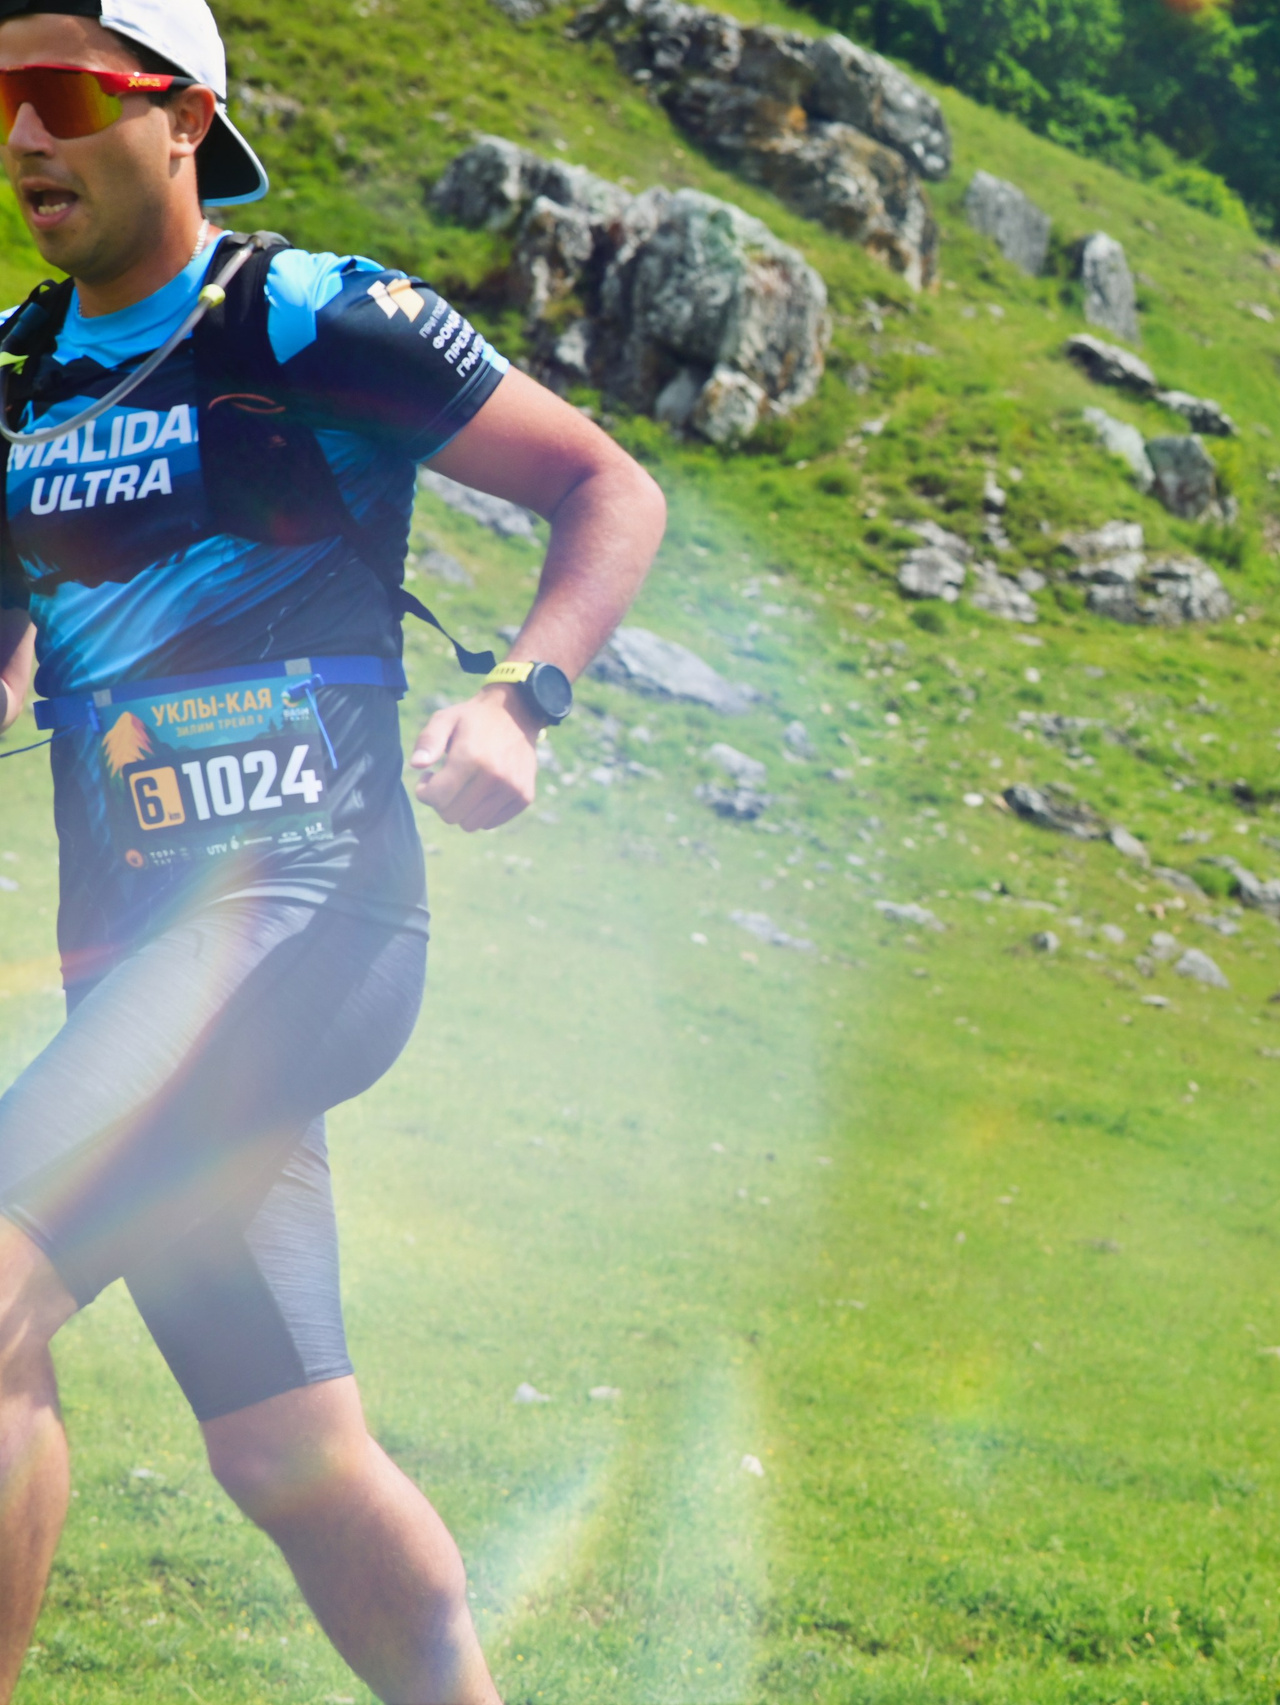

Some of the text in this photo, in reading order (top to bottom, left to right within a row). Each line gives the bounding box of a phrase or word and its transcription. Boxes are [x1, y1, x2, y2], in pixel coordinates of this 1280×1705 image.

[6, 403, 199, 472] MALIDA
[30, 457, 172, 516] ULTRA
[151, 688, 272, 727] УКЛЫ-КАЯ
[134, 776, 165, 825] 6
[181, 744, 323, 821] 1024
